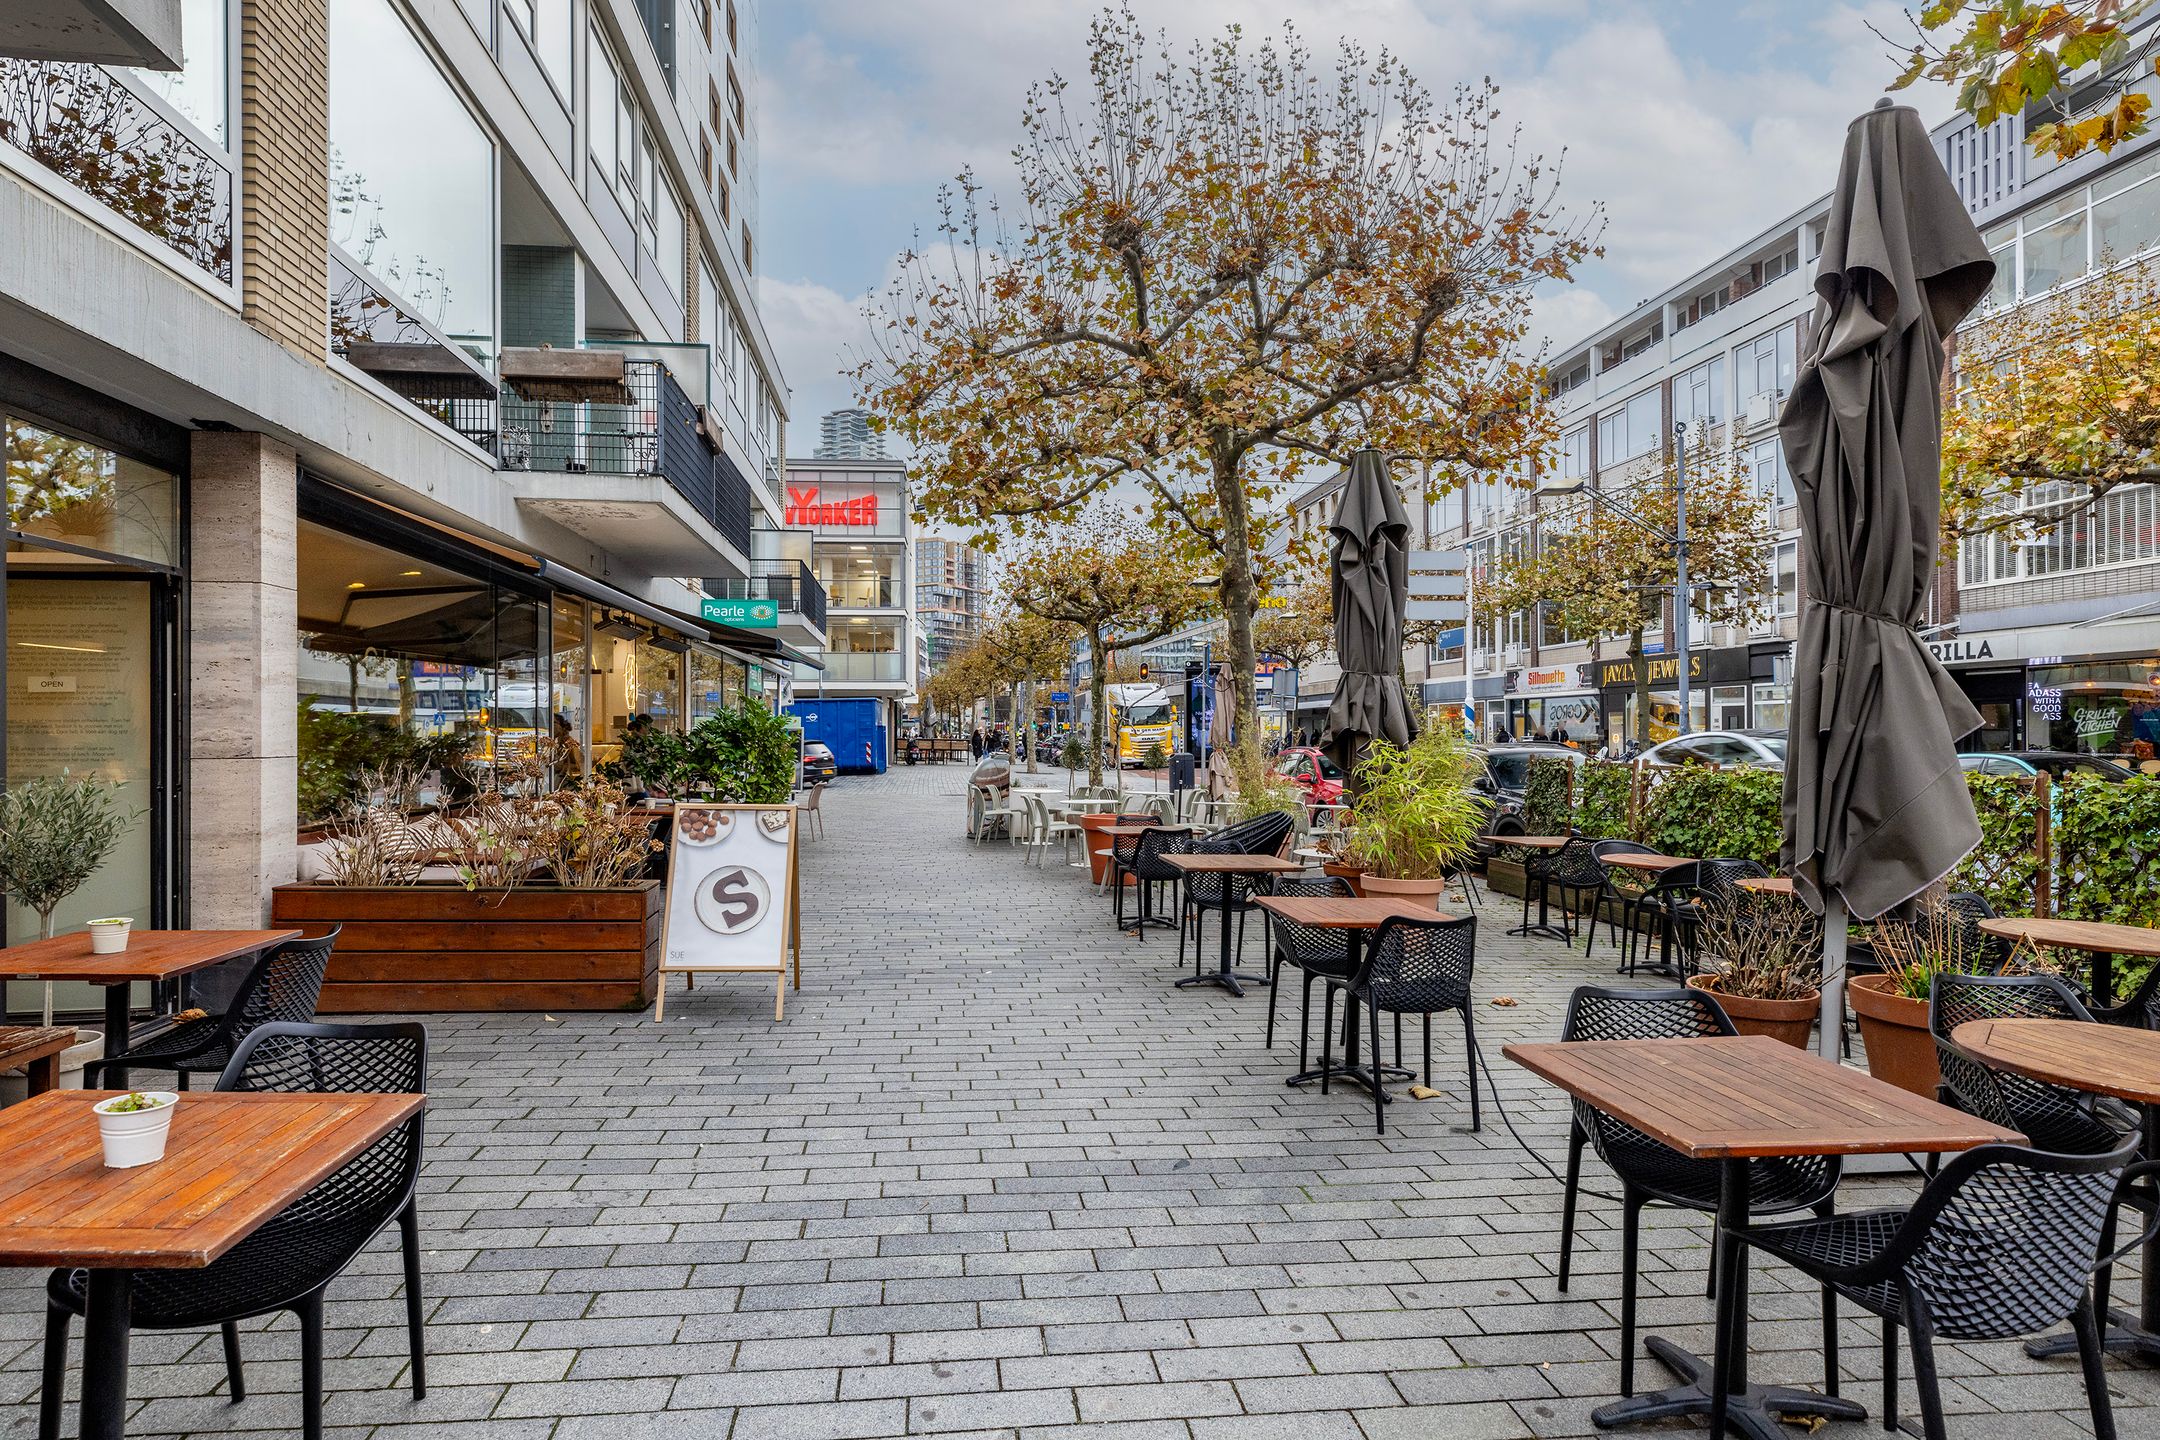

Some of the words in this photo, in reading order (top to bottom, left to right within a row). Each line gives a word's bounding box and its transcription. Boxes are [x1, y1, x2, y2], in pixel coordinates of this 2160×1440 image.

[787, 487, 878, 526] YORKER
[704, 604, 745, 617] Pearle
[1929, 639, 1994, 662] RILLA
[1528, 669, 1566, 685] Silhouette
[1647, 656, 1701, 684] JEWS
[2033, 704, 2062, 713] GOOD
[2042, 712, 2062, 721] ASS
[2075, 716, 2122, 734] KITCHEN
[670, 950, 685, 959] SUE
